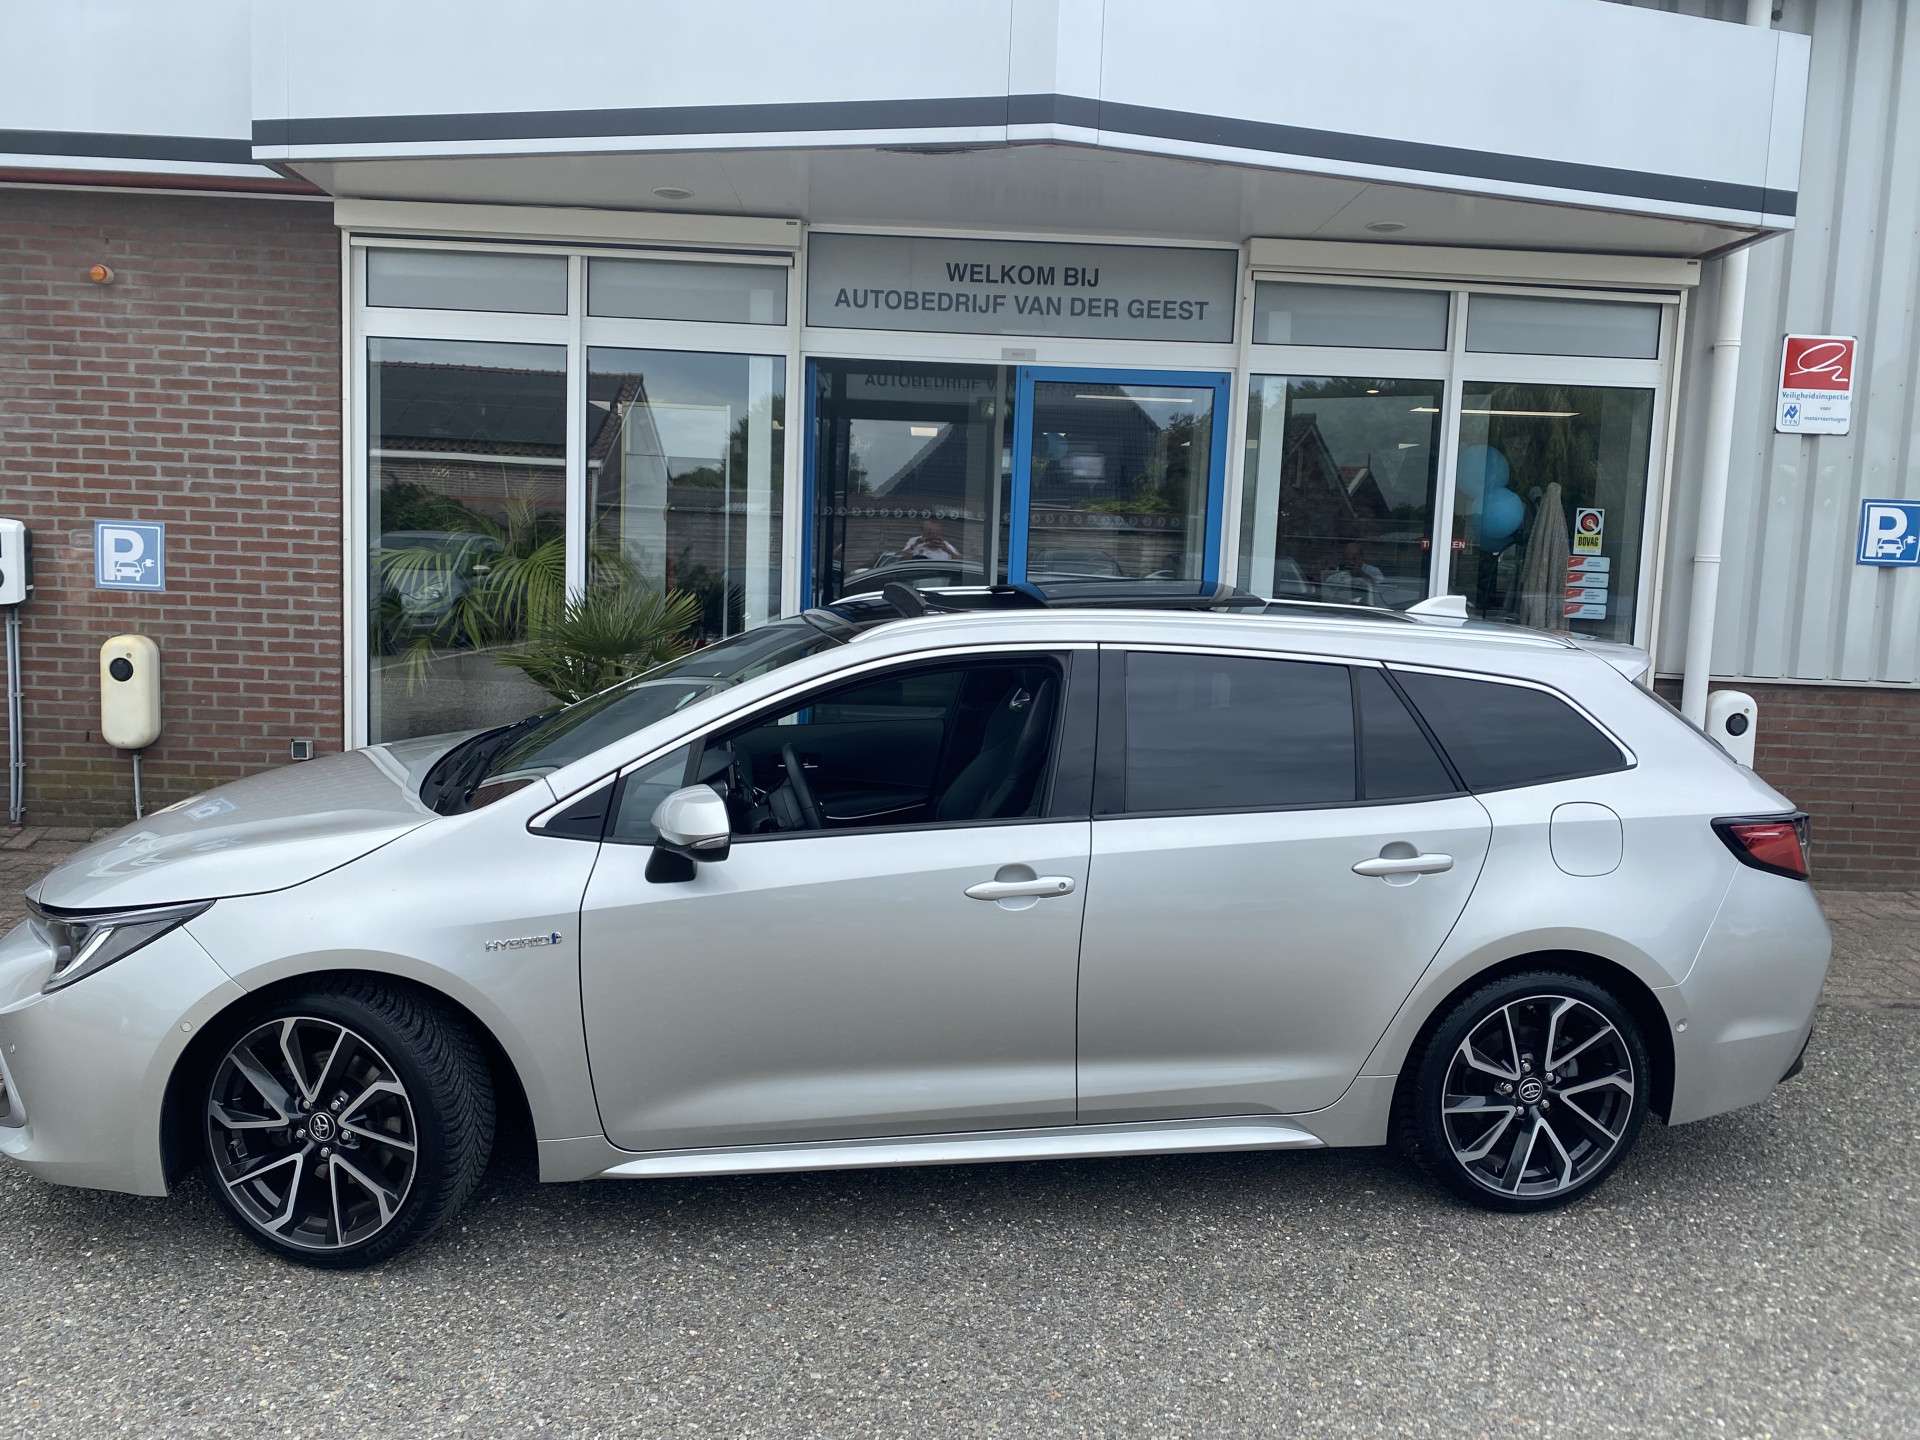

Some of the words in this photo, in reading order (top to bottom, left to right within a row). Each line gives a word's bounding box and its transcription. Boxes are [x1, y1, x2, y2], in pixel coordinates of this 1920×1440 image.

[945, 262, 1056, 287] WELKOM
[1063, 266, 1100, 288] BIJ
[834, 288, 1006, 314] AUTOBEDRIJF
[1014, 295, 1062, 316] VAN
[1070, 297, 1119, 319] DER
[1126, 299, 1210, 321] GEEST
[1782, 391, 1849, 401] Veiligheidsinspectie
[1865, 507, 1908, 557] P
[104, 528, 145, 581] P
[485, 935, 549, 952] HYBRID
